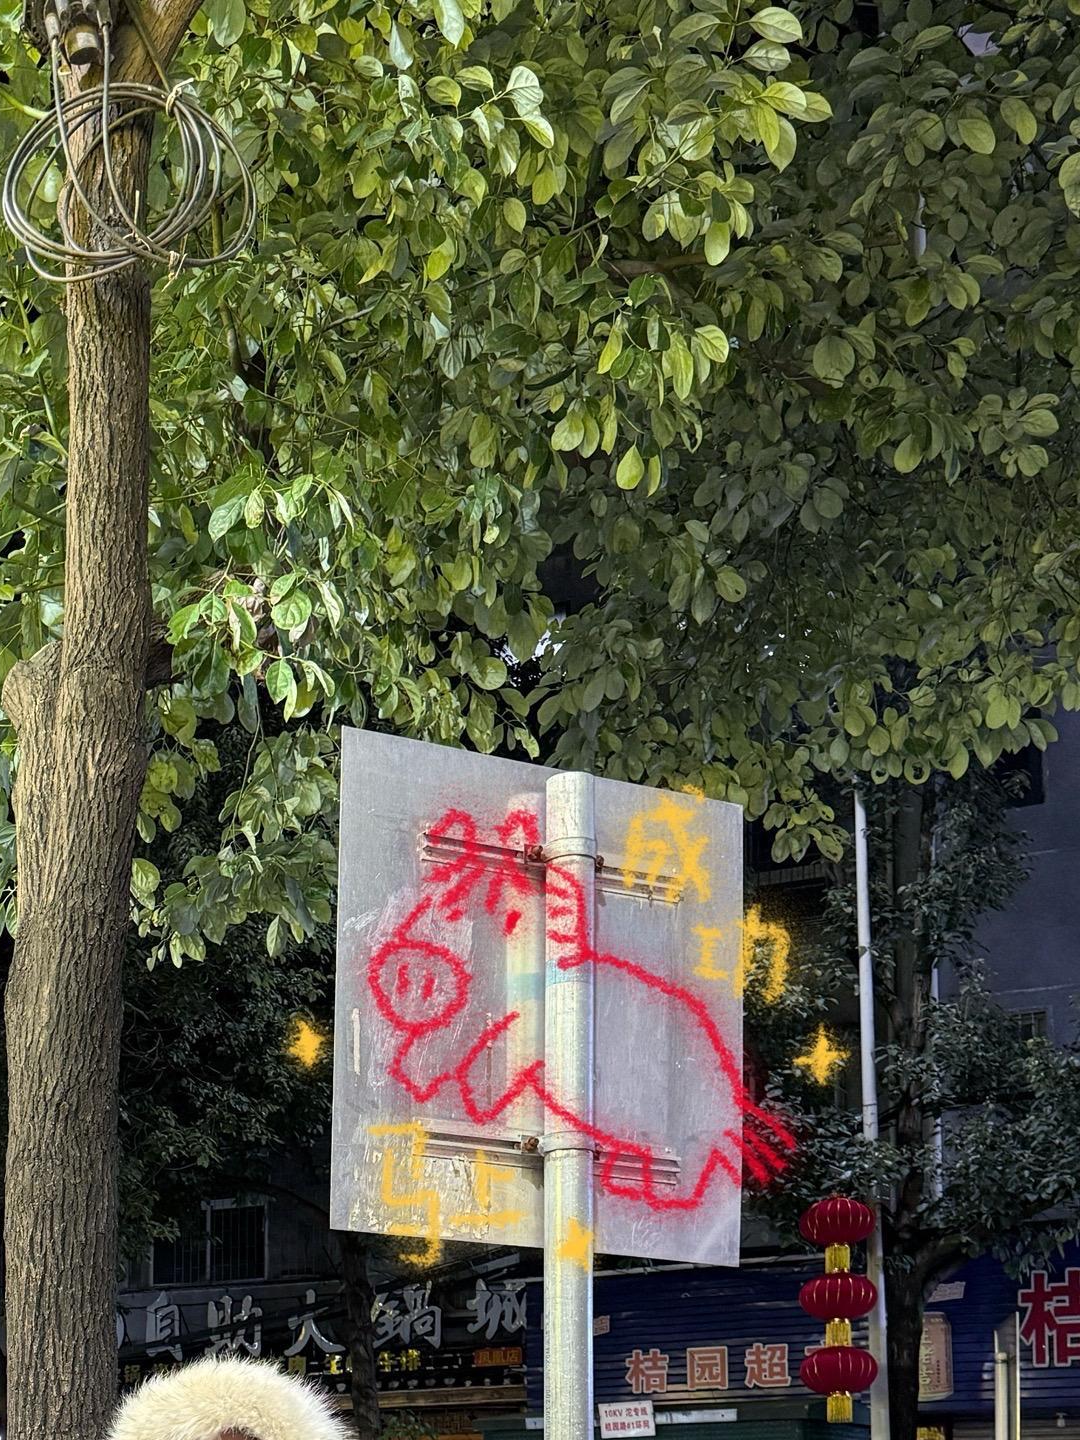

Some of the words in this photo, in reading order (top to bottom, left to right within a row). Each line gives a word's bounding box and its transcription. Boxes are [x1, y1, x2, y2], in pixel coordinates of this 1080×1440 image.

[625, 1342, 826, 1394] 桔园超
[604, 1408, 623, 1417] 10KV
